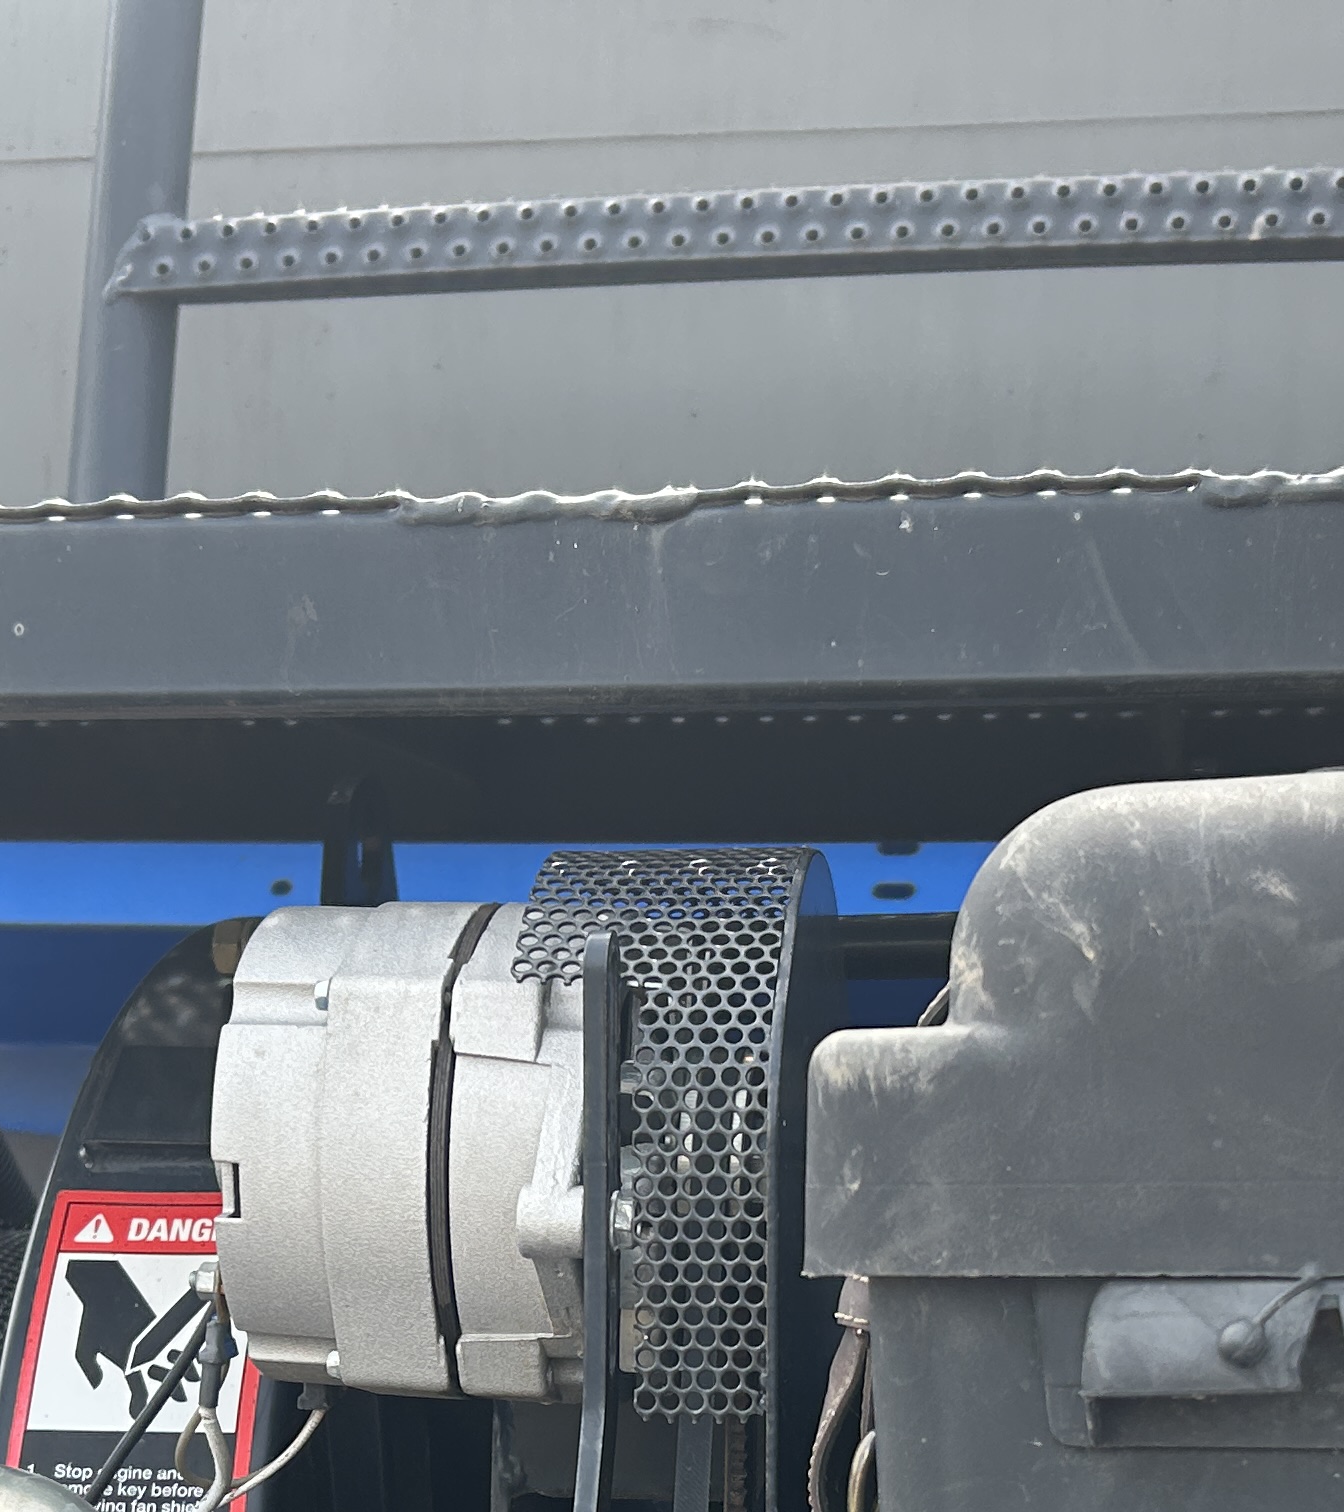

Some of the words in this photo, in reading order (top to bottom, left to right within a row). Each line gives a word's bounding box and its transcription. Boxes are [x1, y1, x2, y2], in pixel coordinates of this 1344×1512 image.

[127, 1217, 216, 1242] DANG
[54, 1461, 93, 1482] Stop
[117, 1483, 147, 1500] key
[151, 1482, 204, 1498] before
